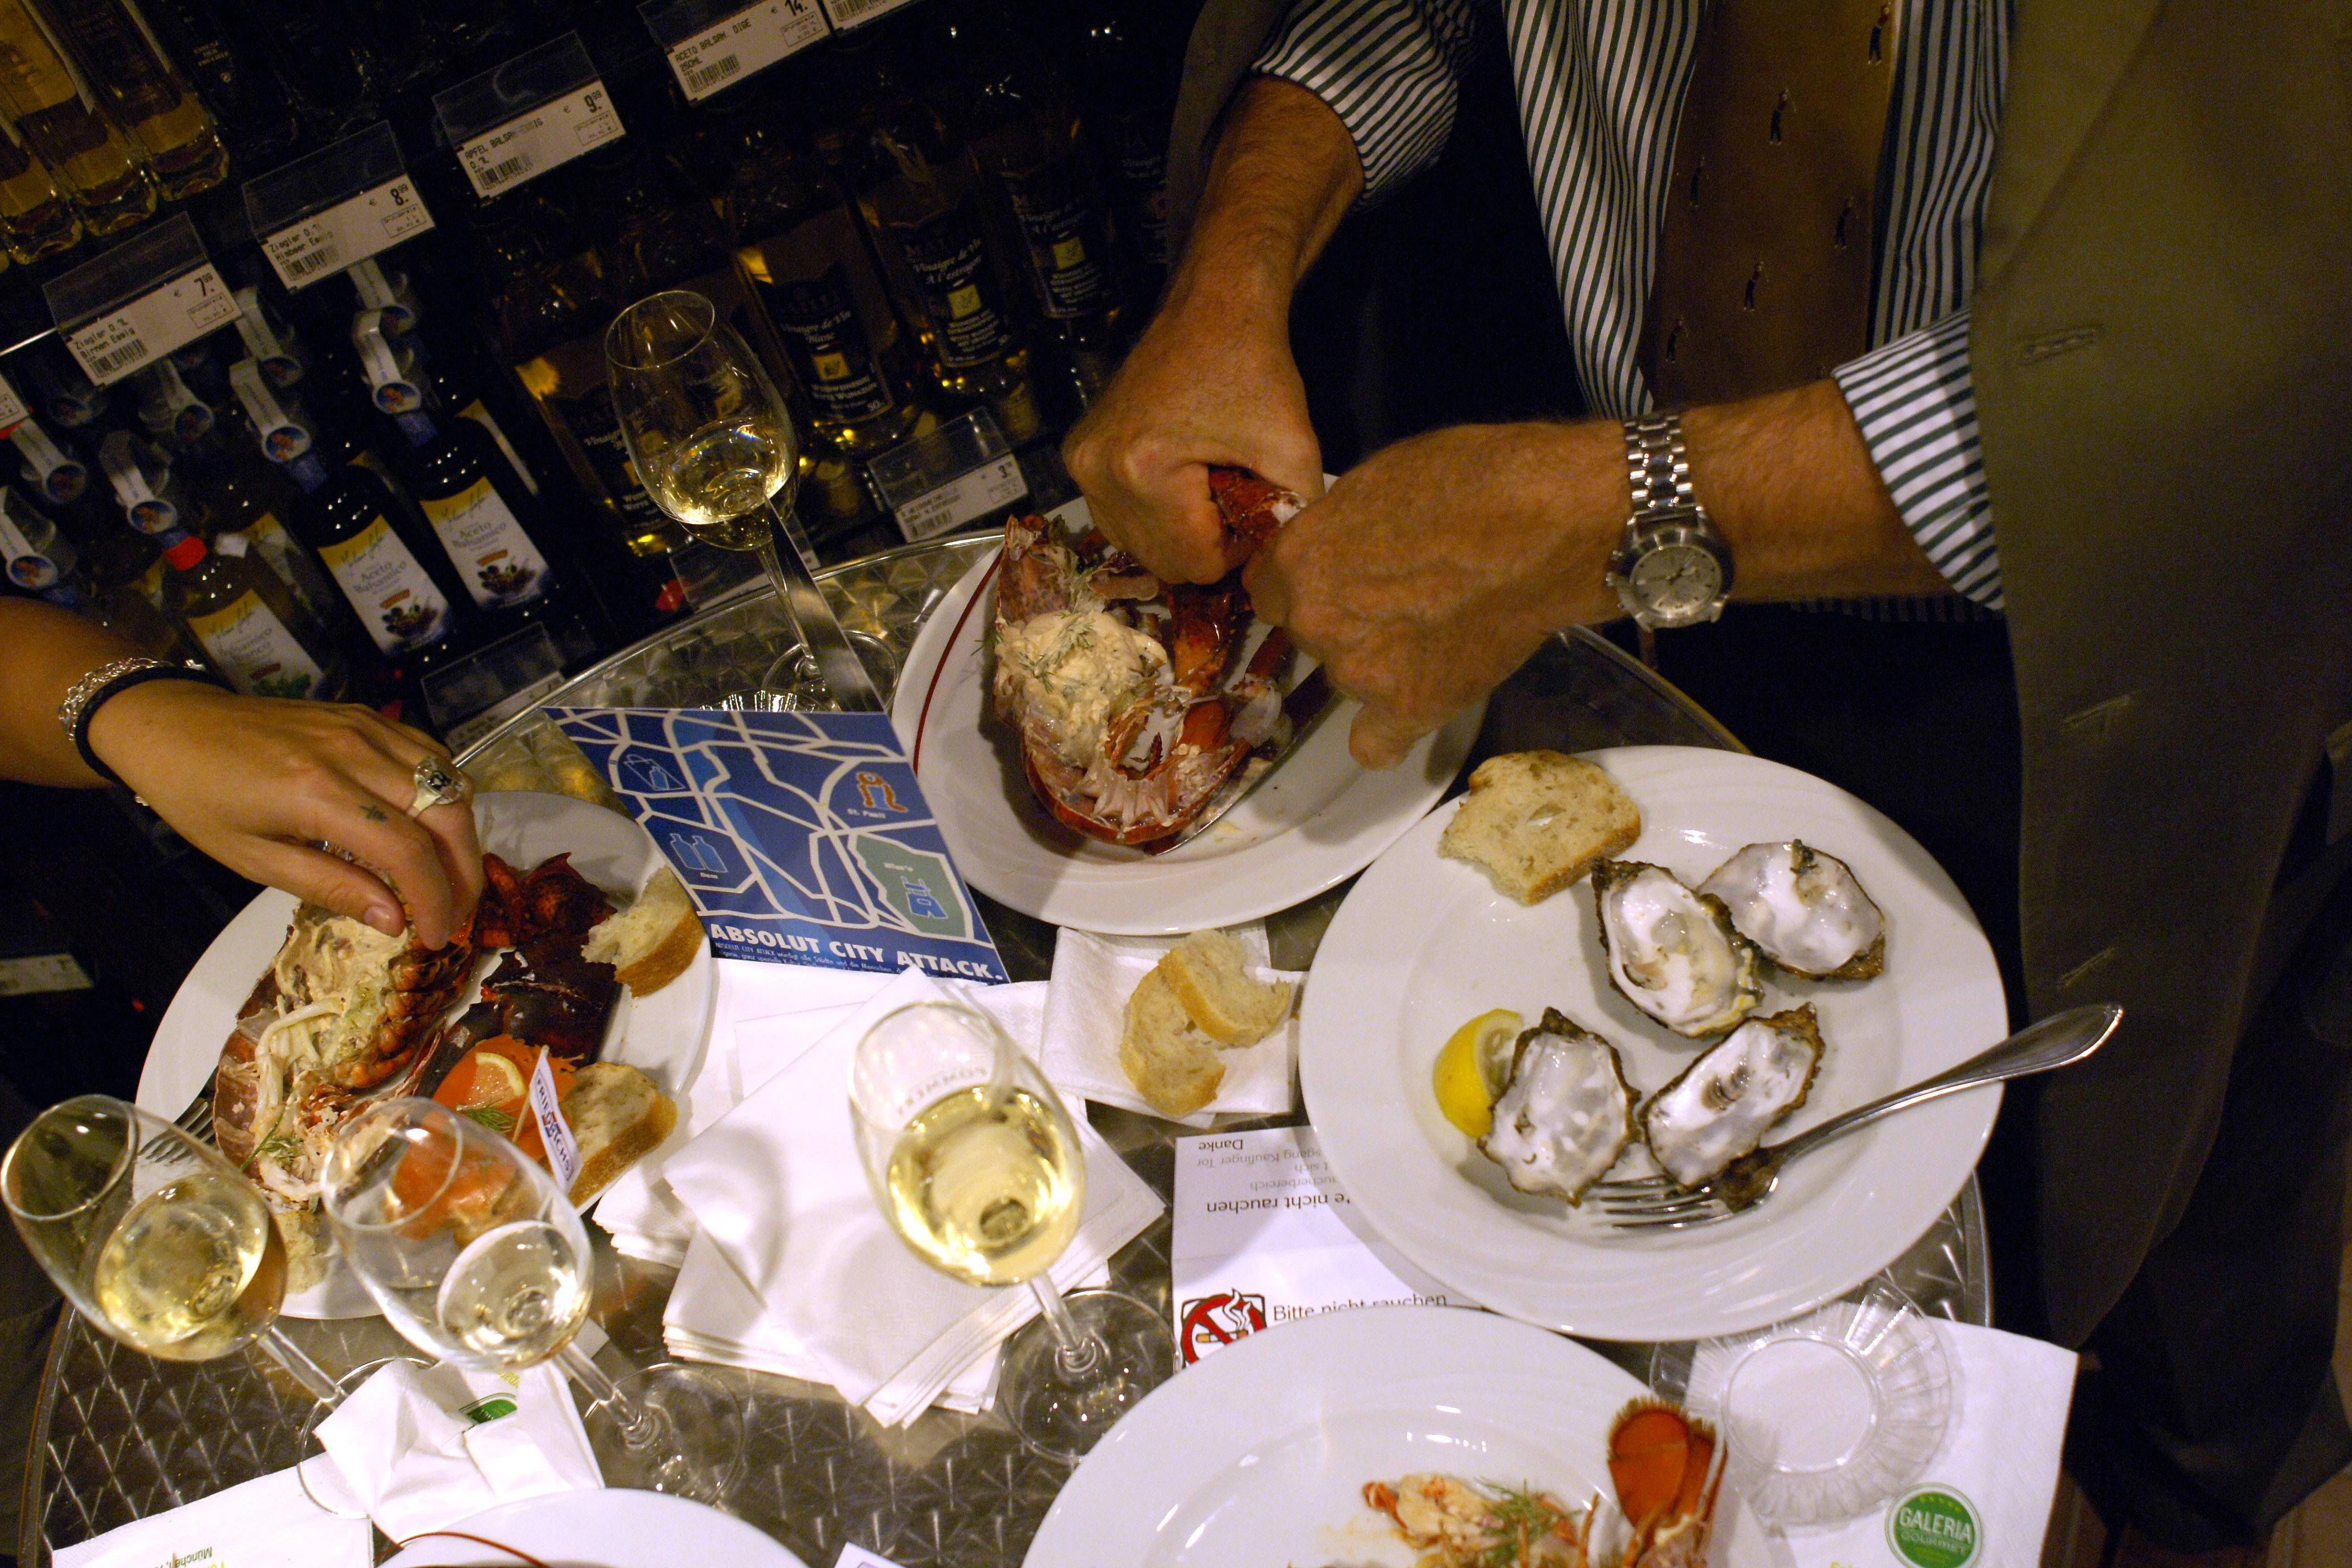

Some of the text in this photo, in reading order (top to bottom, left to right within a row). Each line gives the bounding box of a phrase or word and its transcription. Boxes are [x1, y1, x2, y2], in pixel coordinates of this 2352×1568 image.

[465, 145, 488, 159] APFEL
[710, 923, 1003, 981] ABSOLUT CITY ATTACK.
[1198, 1139, 1243, 1151] Danke
[1197, 1147, 1322, 1168] sgang Kaufinger Tor
[1206, 1197, 1278, 1213] rauchen
[1284, 1193, 1328, 1209] nicht
[1273, 1304, 1314, 1321] Bitte
[1899, 1506, 1974, 1545] GALERIA
